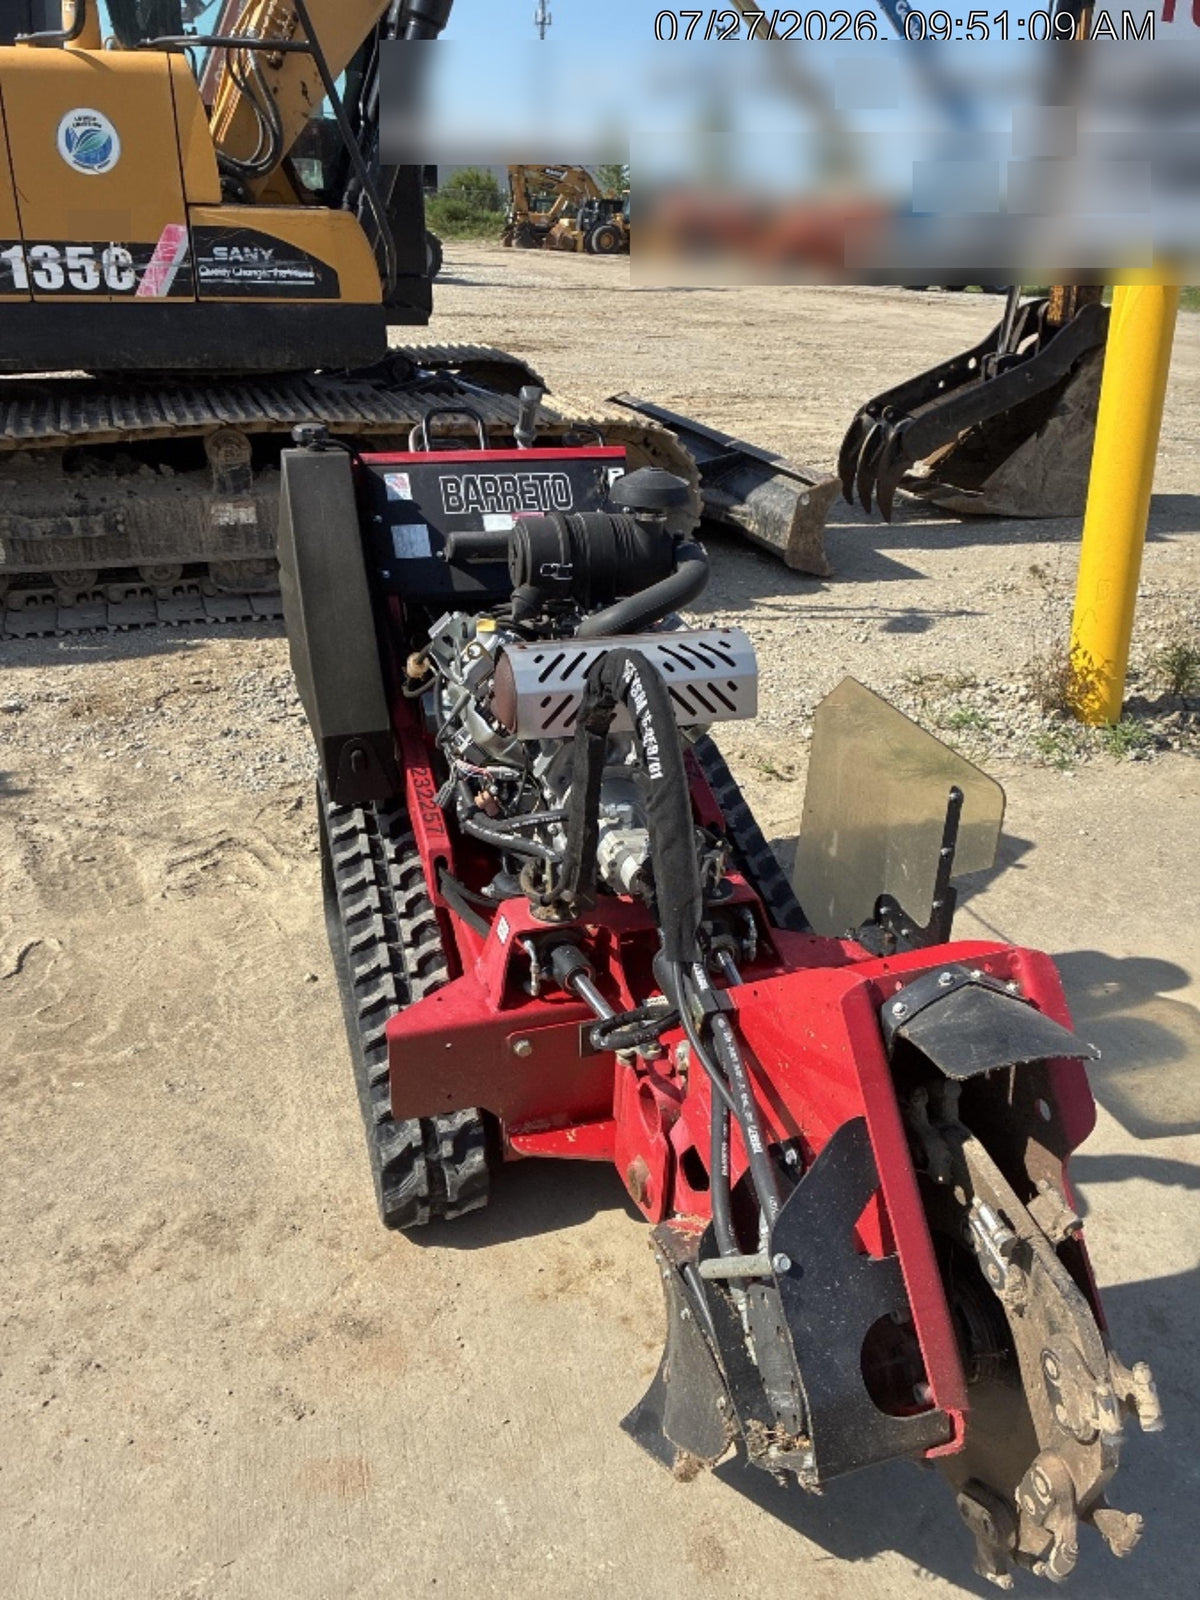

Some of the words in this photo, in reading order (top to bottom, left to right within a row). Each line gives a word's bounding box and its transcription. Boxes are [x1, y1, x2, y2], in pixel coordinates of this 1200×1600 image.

[212, 246, 274, 262] SANY
[438, 472, 574, 515] BARRETO
[410, 767, 446, 834] 232257
